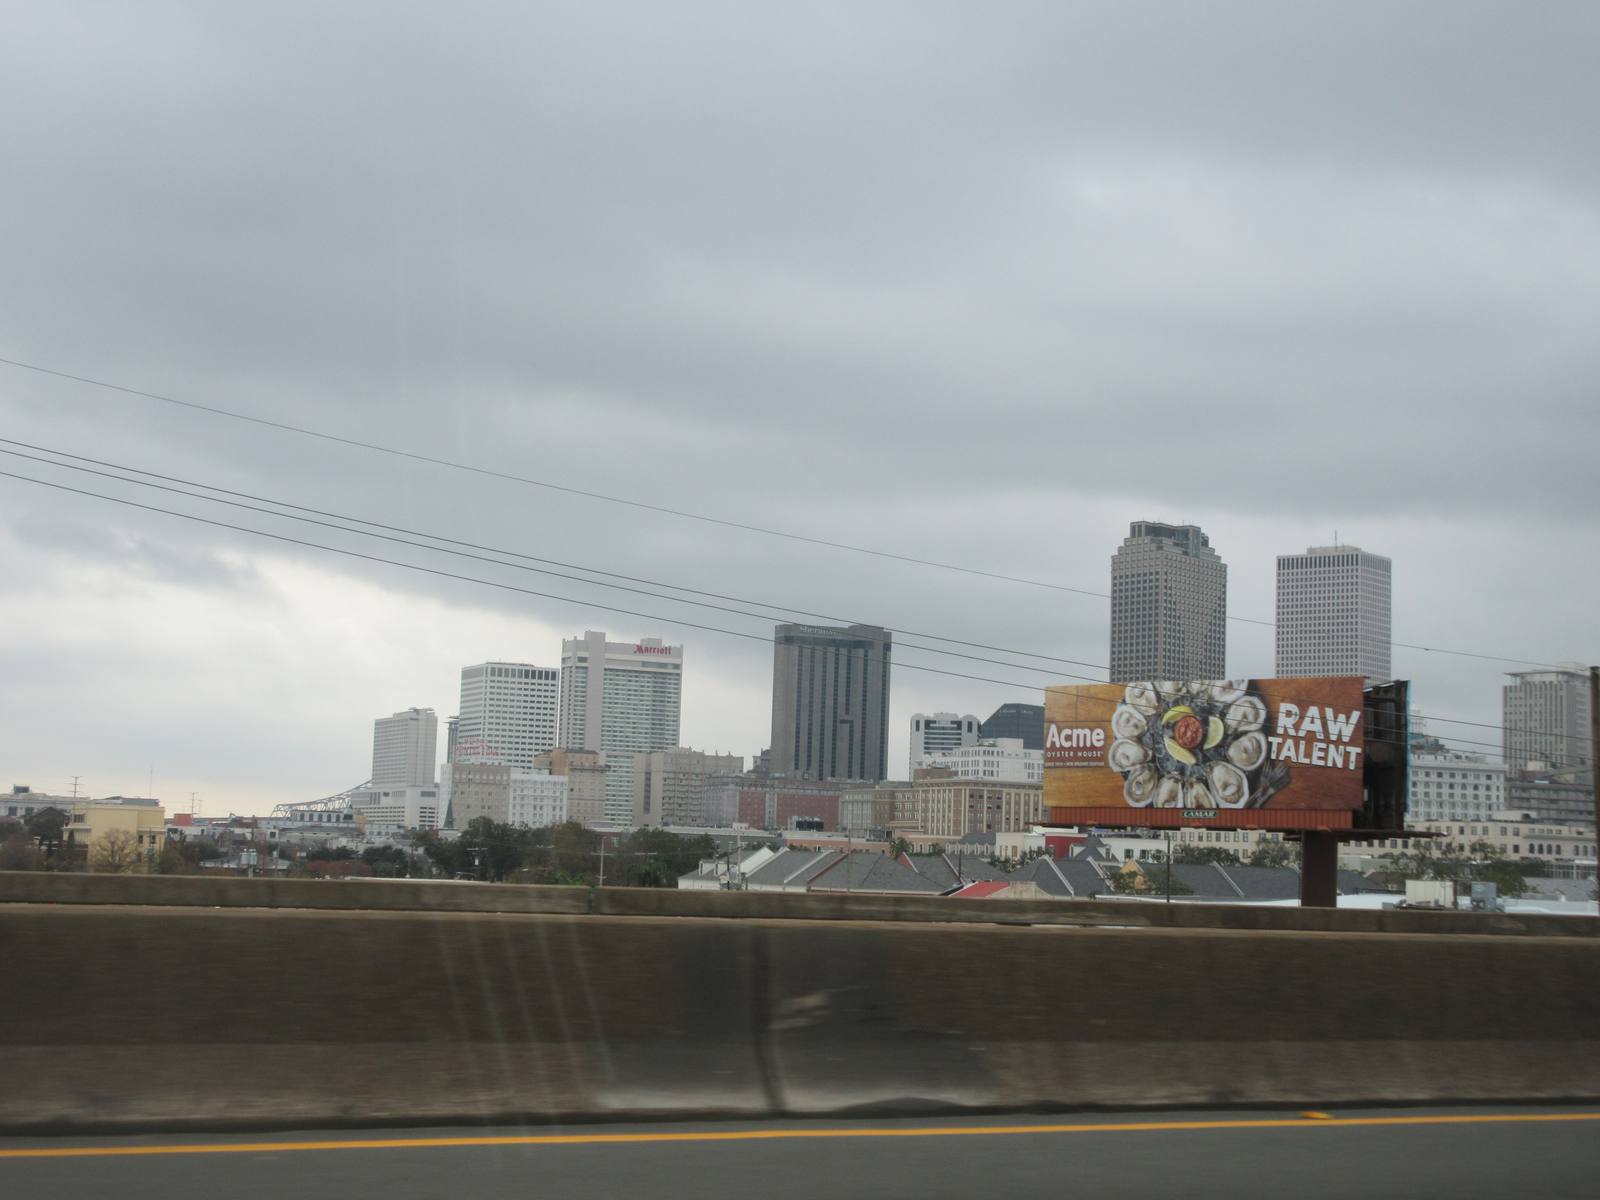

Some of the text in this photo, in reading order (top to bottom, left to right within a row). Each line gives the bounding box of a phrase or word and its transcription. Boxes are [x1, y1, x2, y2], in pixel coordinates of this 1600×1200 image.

[1046, 723, 1105, 748] Acme
[1276, 702, 1361, 743] RAW
[1268, 736, 1362, 770] TALENT
